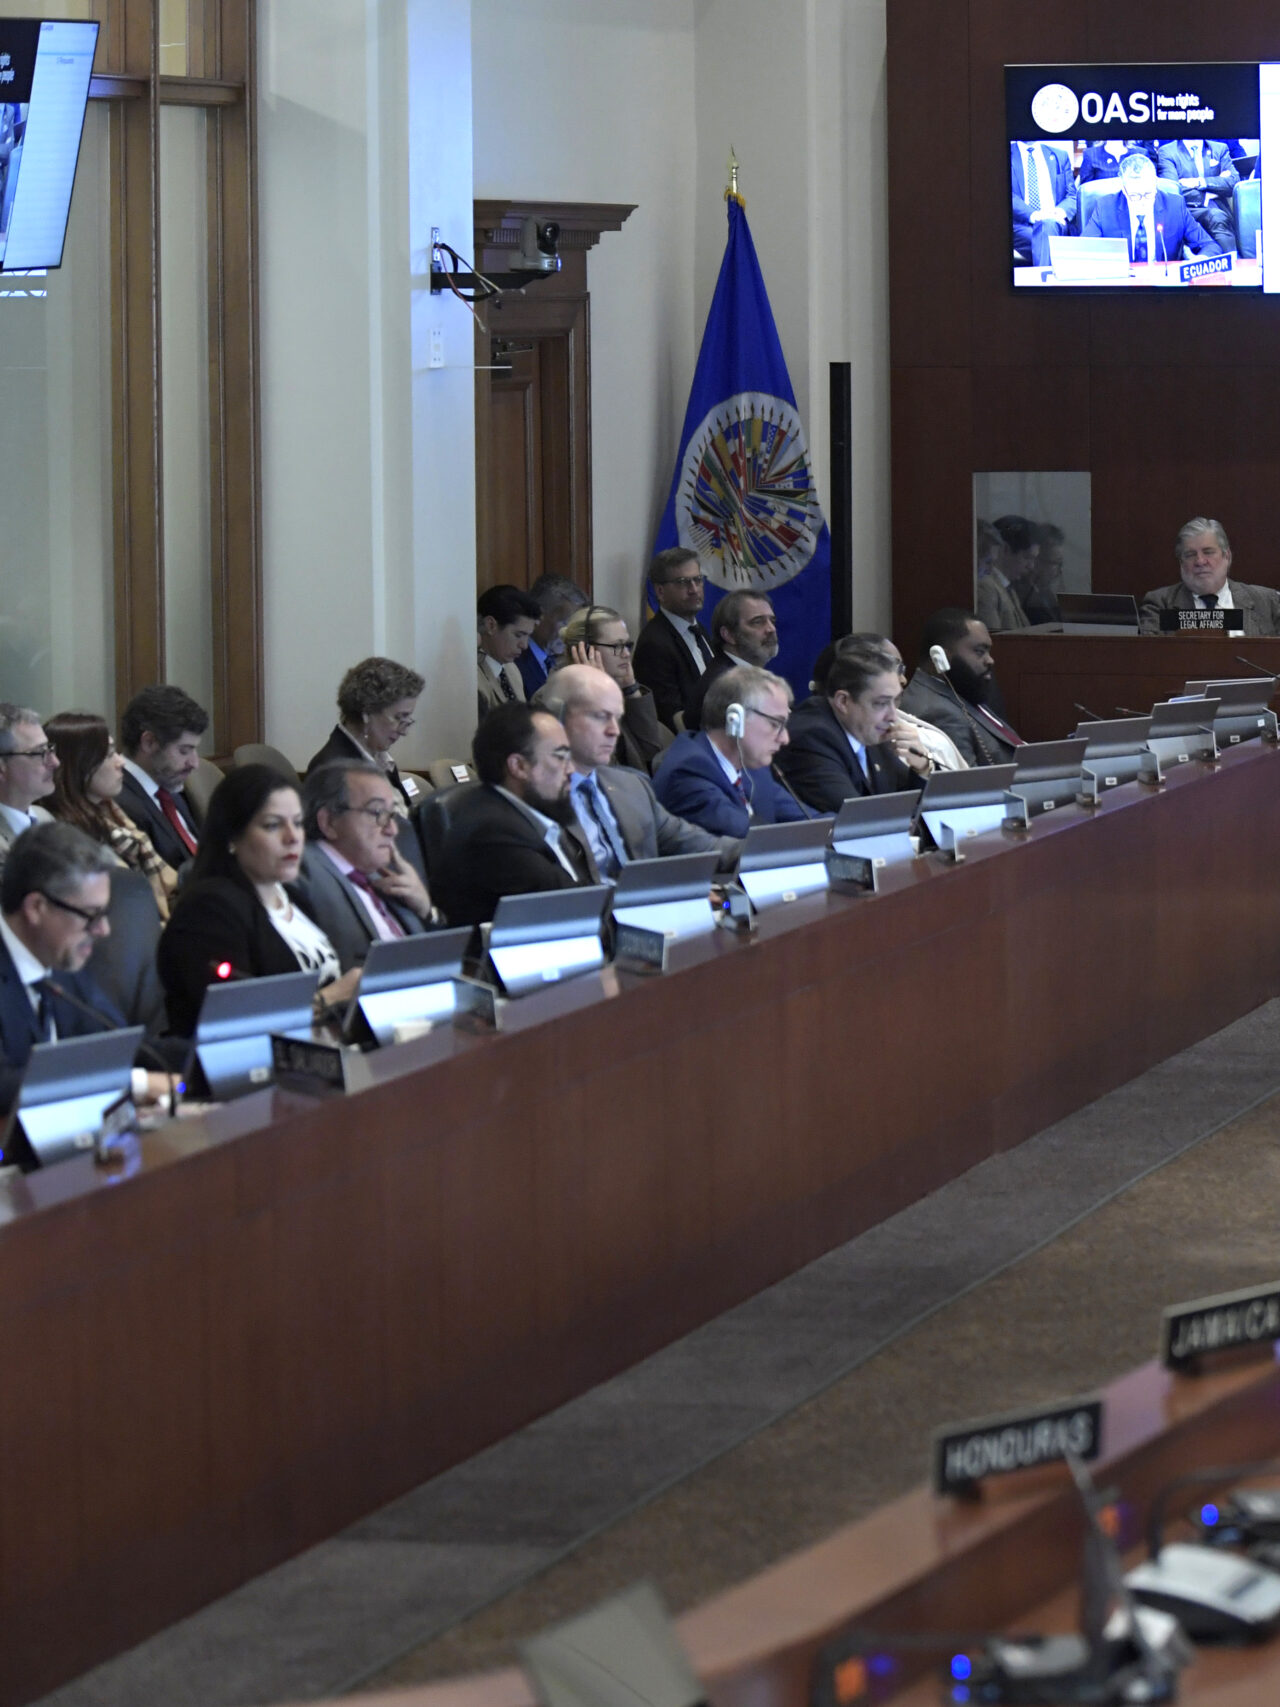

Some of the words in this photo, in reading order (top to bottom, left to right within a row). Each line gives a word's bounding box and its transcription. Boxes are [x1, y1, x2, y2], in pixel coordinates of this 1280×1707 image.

[1081, 91, 1150, 123] OAS
[1175, 93, 1200, 109] rights
[1186, 106, 1214, 123] people
[1183, 258, 1229, 279] ECUADOR
[1178, 610, 1211, 620] SECRETARY
[1212, 610, 1225, 620] FOR
[1180, 620, 1198, 629] LEGAL
[1199, 620, 1224, 629] AFFAIRS
[1171, 1299, 1275, 1357] JAMAICA
[944, 1410, 1094, 1480] HONDURAS
